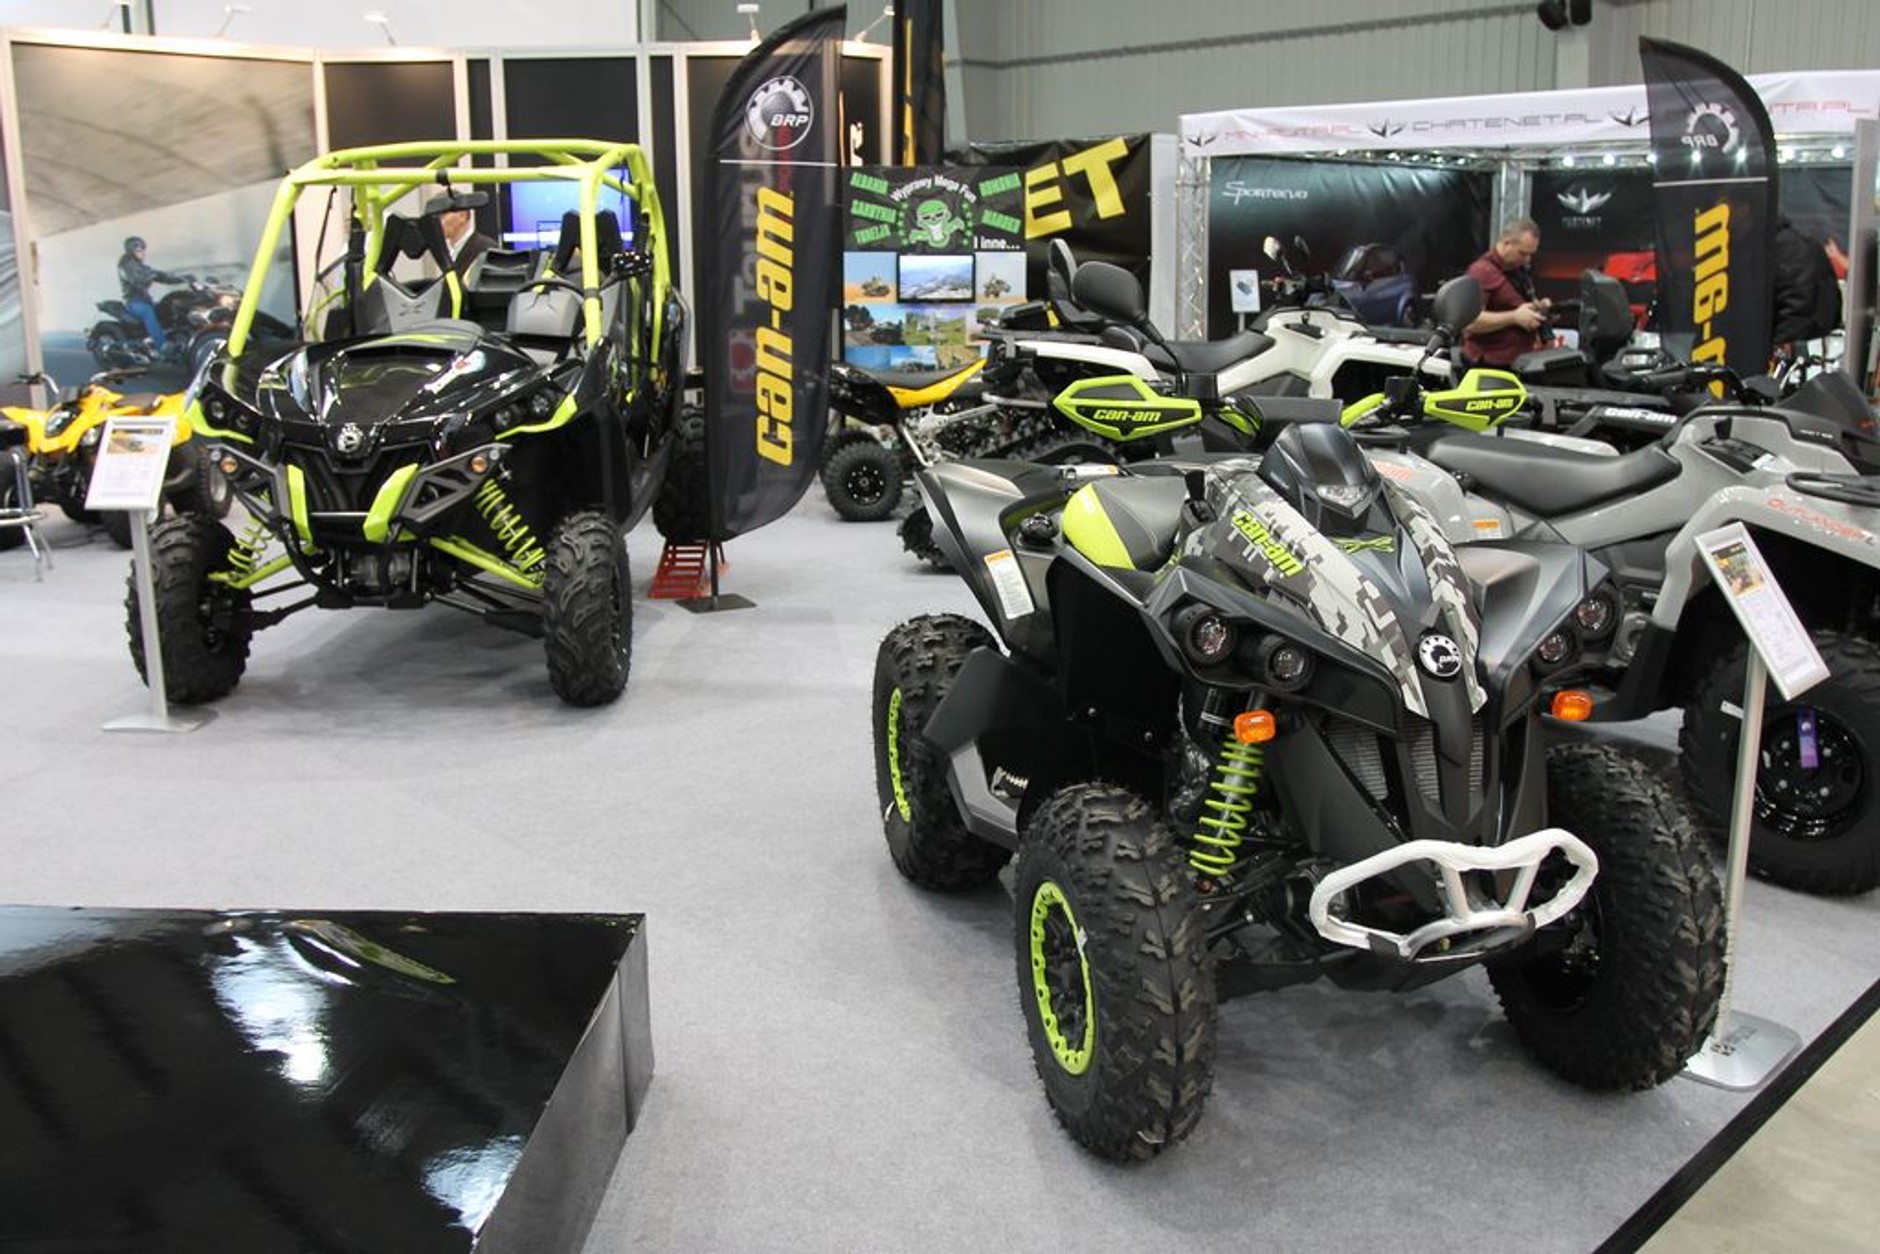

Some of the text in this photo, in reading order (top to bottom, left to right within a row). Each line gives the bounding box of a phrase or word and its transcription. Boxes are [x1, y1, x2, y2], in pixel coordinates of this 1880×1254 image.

[771, 114, 809, 127] BRP
[755, 186, 794, 467] can-am
[1464, 398, 1514, 411] can-am
[1092, 409, 1162, 422] can-am
[1604, 407, 1678, 424] can-am
[1232, 508, 1303, 577] can-am
